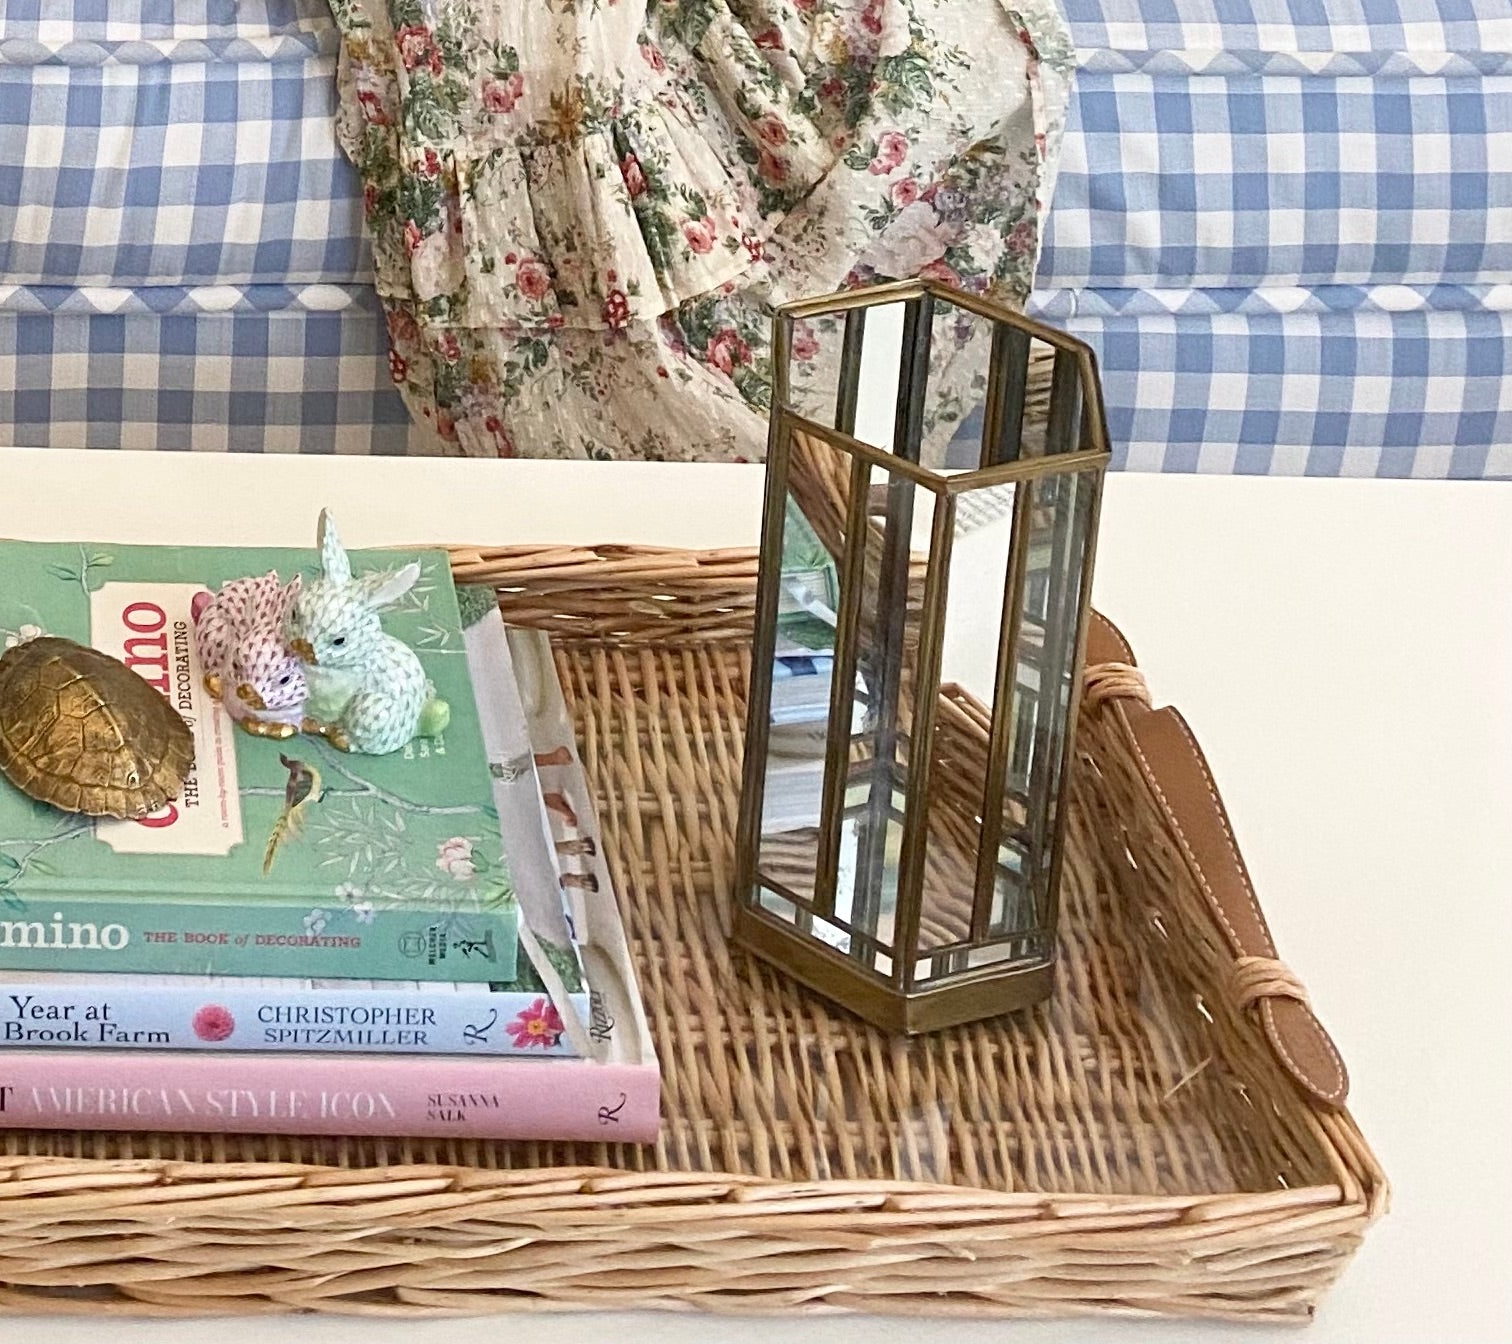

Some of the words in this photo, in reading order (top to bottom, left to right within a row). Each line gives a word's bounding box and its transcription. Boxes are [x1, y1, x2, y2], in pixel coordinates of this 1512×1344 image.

[173, 620, 194, 712] DECORATING
[184, 776, 200, 809] THE
[143, 931, 177, 944] THE
[183, 932, 229, 945] BOOK
[234, 933, 250, 948] of
[254, 934, 362, 949] DECORATING
[8, 995, 75, 1021] Year
[85, 1002, 112, 1021] at
[257, 1005, 437, 1027] CHRISTOPHER
[4, 1021, 88, 1042] Brook
[98, 1023, 171, 1044] Farm
[263, 1027, 429, 1046] SPITZMILLER
[30, 1086, 197, 1114] AMERICAN
[205, 1088, 309, 1118] STYLE
[318, 1090, 396, 1120] ICON
[428, 1093, 500, 1108] SUSANNA
[427, 1109, 466, 1121] SALK
